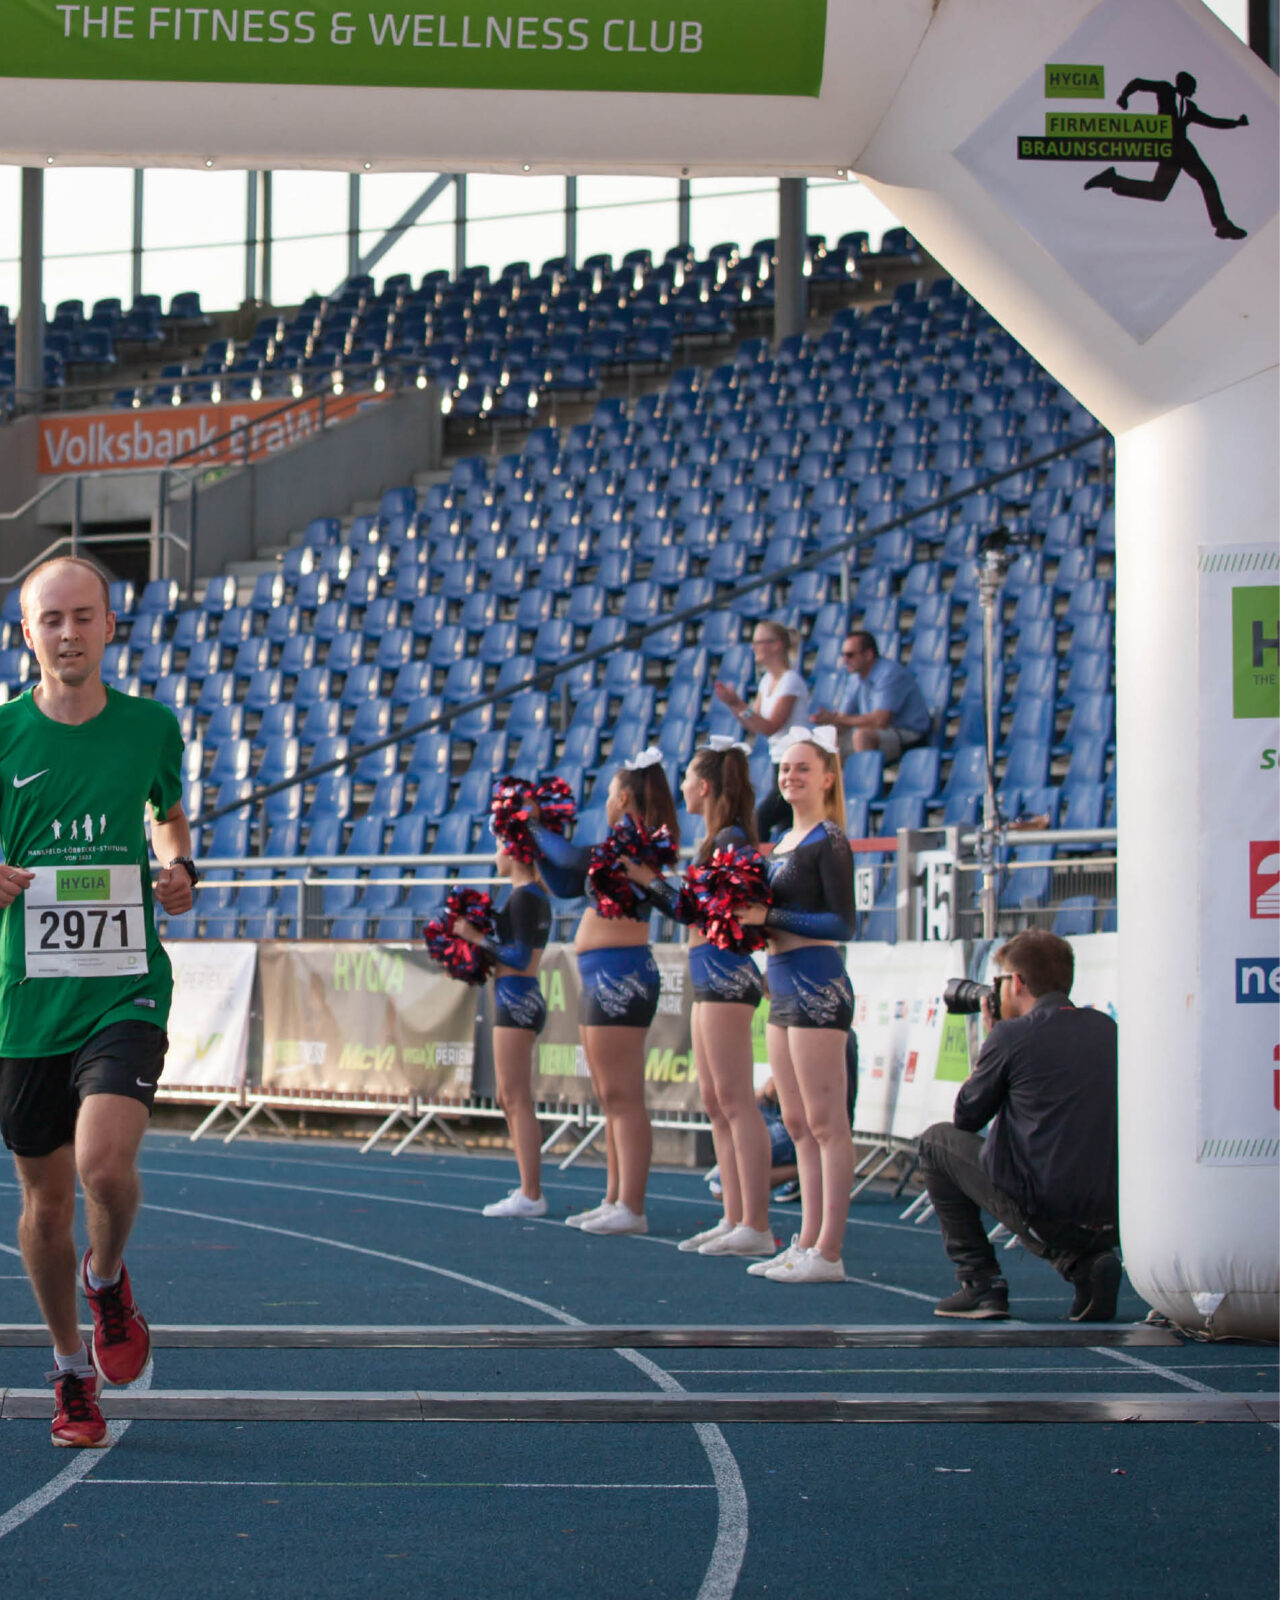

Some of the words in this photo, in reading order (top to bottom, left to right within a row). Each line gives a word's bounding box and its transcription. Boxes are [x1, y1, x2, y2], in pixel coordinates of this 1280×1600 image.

[56, 4, 134, 40] THE
[148, 8, 316, 44] FITNESS
[330, 12, 357, 45] &
[369, 13, 589, 51] WELLNESS
[602, 19, 703, 53] CLUB
[1048, 71, 1100, 87] HYGIA
[1050, 117, 1168, 134] FIRMENLAUF
[1020, 140, 1173, 158] BRAUNSCHWEIG
[43, 415, 219, 468] Volksbank
[61, 877, 106, 889] HYGIA
[39, 909, 129, 950] 2971
